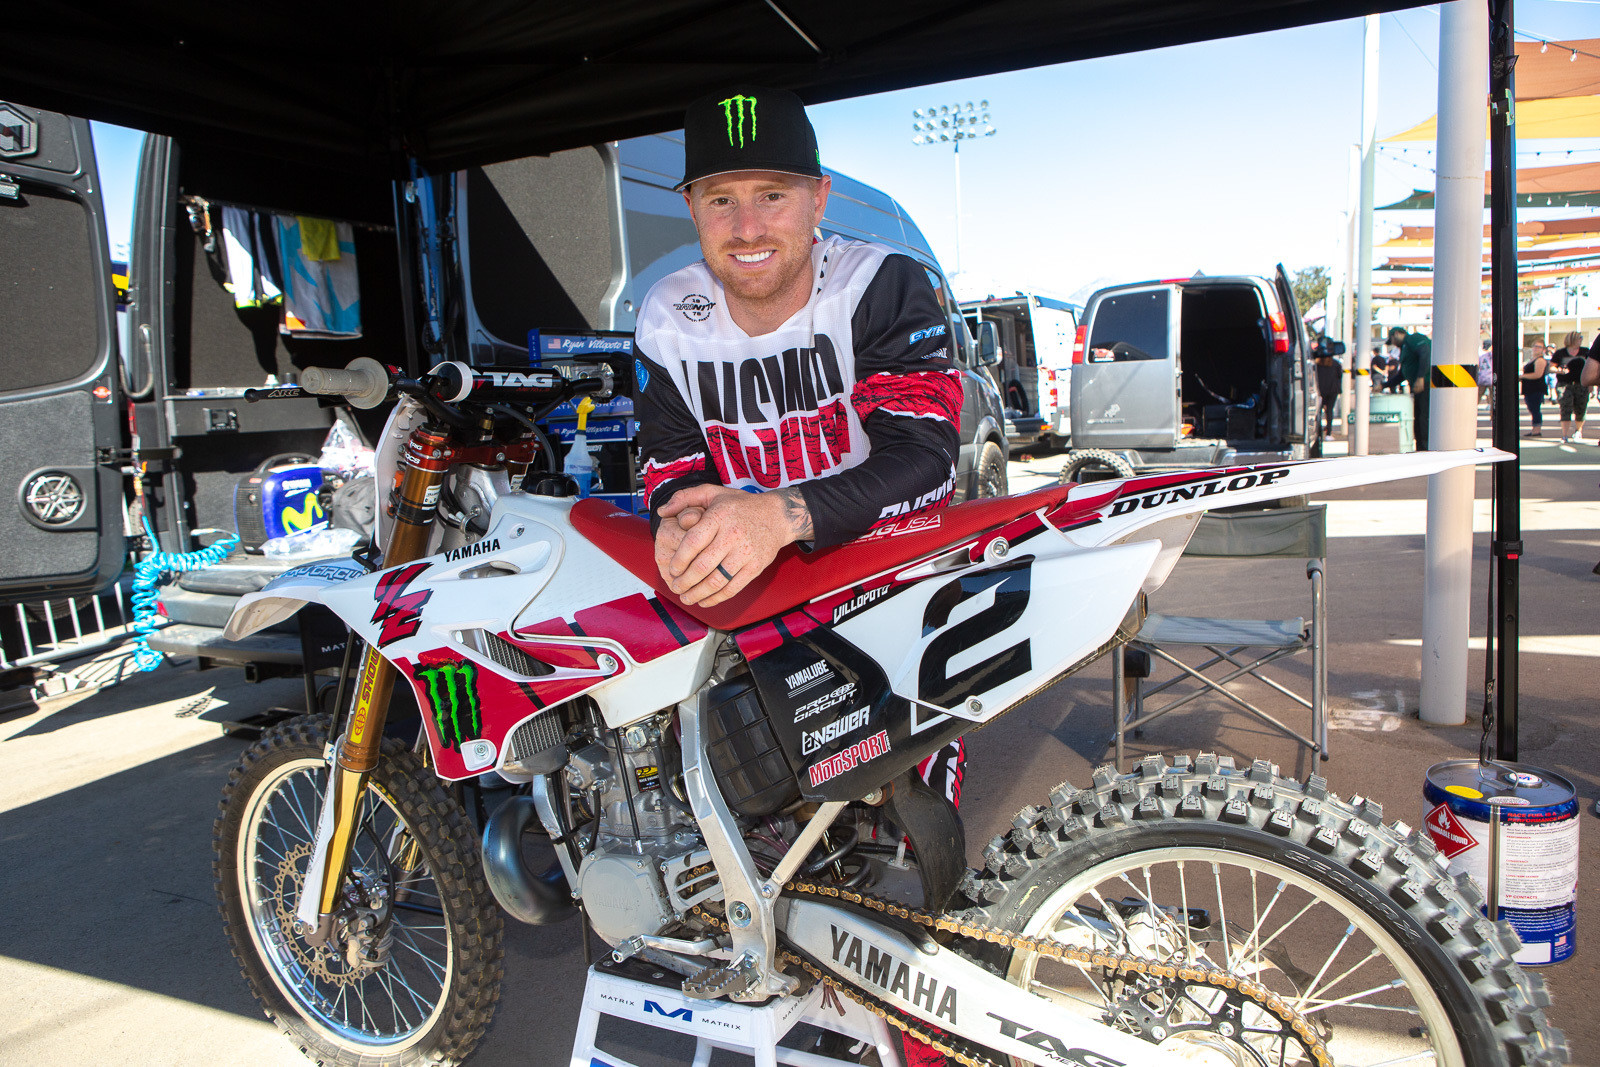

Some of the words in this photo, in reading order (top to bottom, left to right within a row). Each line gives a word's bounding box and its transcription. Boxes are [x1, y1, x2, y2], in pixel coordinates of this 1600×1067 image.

[562, 340, 585, 352] Ryan
[622, 341, 631, 350] 2
[909, 324, 946, 345] GYTR
[267, 388, 301, 398] ARC
[483, 371, 554, 388] TAG
[1107, 468, 1290, 518] DUNLOP
[445, 539, 501, 562] YAMAHA
[309, 565, 364, 581] CIRCU
[833, 584, 891, 624] VILLOPOTO
[918, 558, 1033, 736] 2
[362, 648, 380, 705] SHOW
[785, 660, 829, 690] YAMALUBE
[794, 689, 857, 723] CIRCUIT
[795, 694, 830, 716] PRO
[802, 705, 870, 756] ANSWER
[1450, 833, 1469, 846] LIQUID
[830, 923, 957, 1025] YAMAHA
[600, 993, 635, 1006] MATRIX
[702, 1017, 741, 1030] MATRIX
